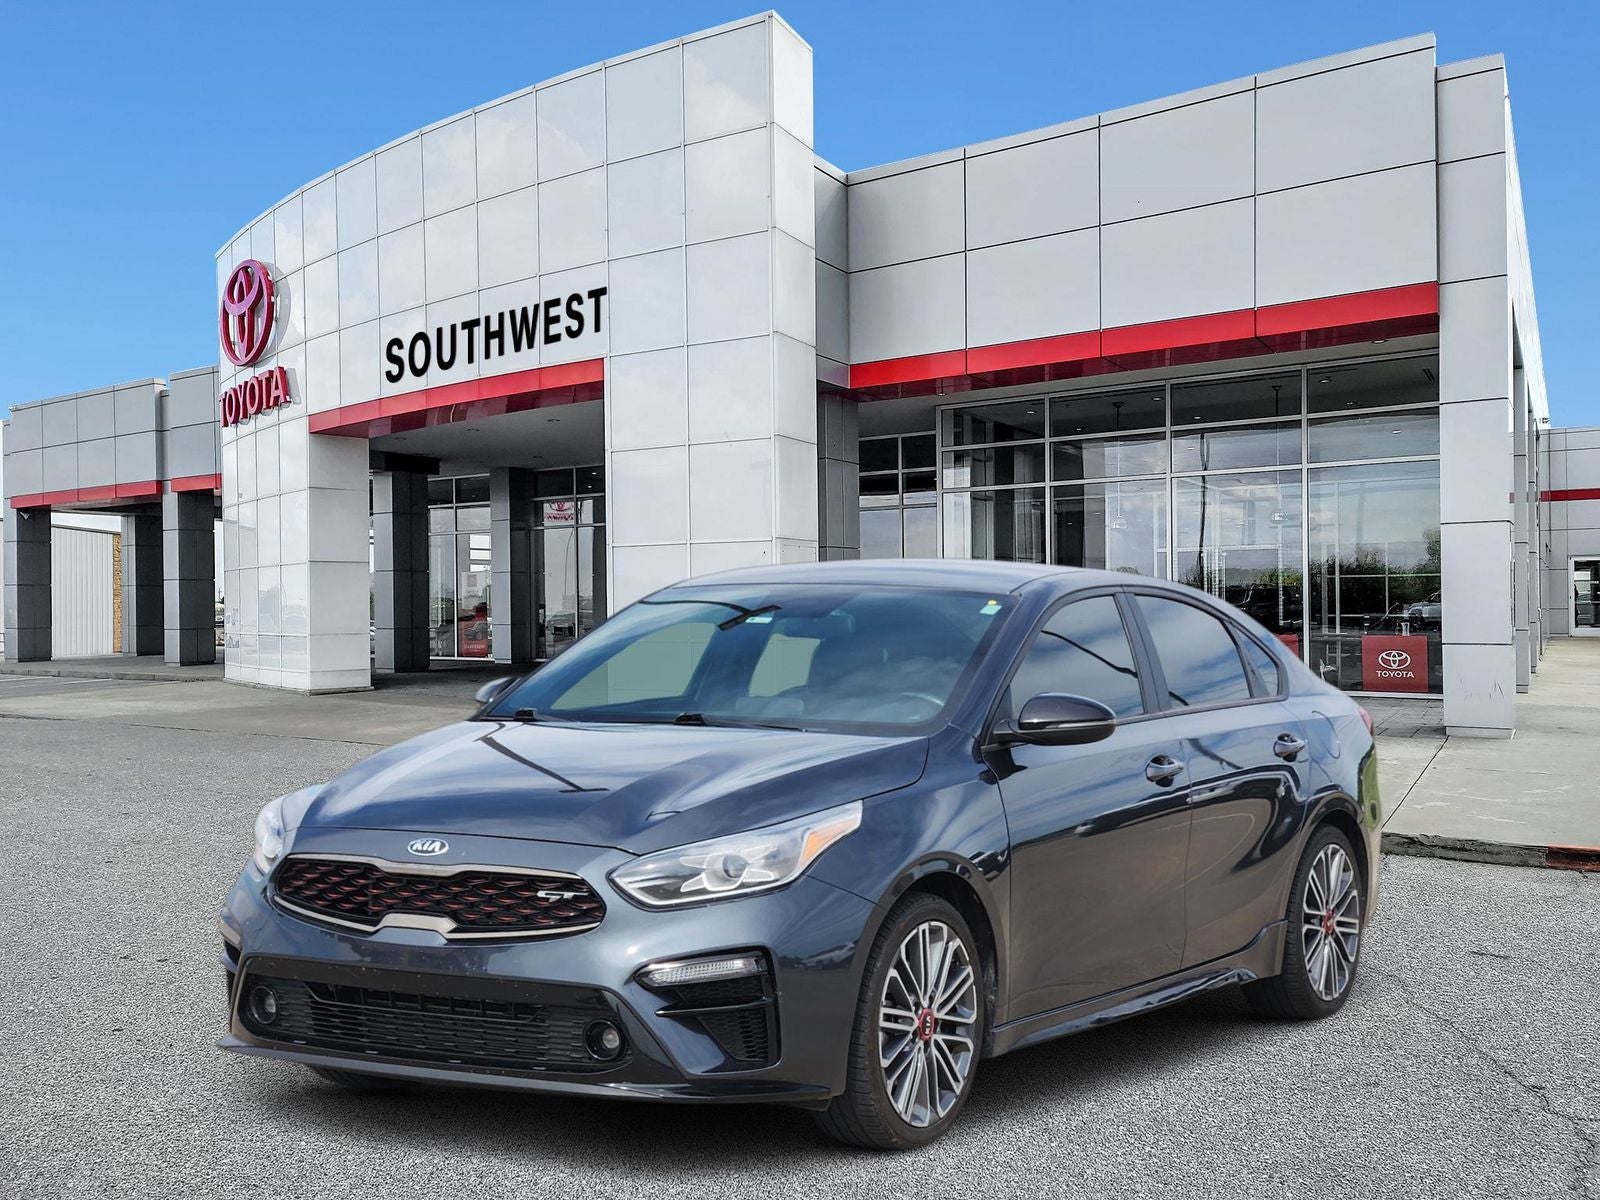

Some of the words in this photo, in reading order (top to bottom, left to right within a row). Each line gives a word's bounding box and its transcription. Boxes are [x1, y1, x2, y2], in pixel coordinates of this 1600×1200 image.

[385, 287, 608, 383] SOUTHWEST
[219, 366, 291, 427] TOYOTA
[1376, 670, 1414, 678] TOYOTA
[537, 890, 588, 902] GT
